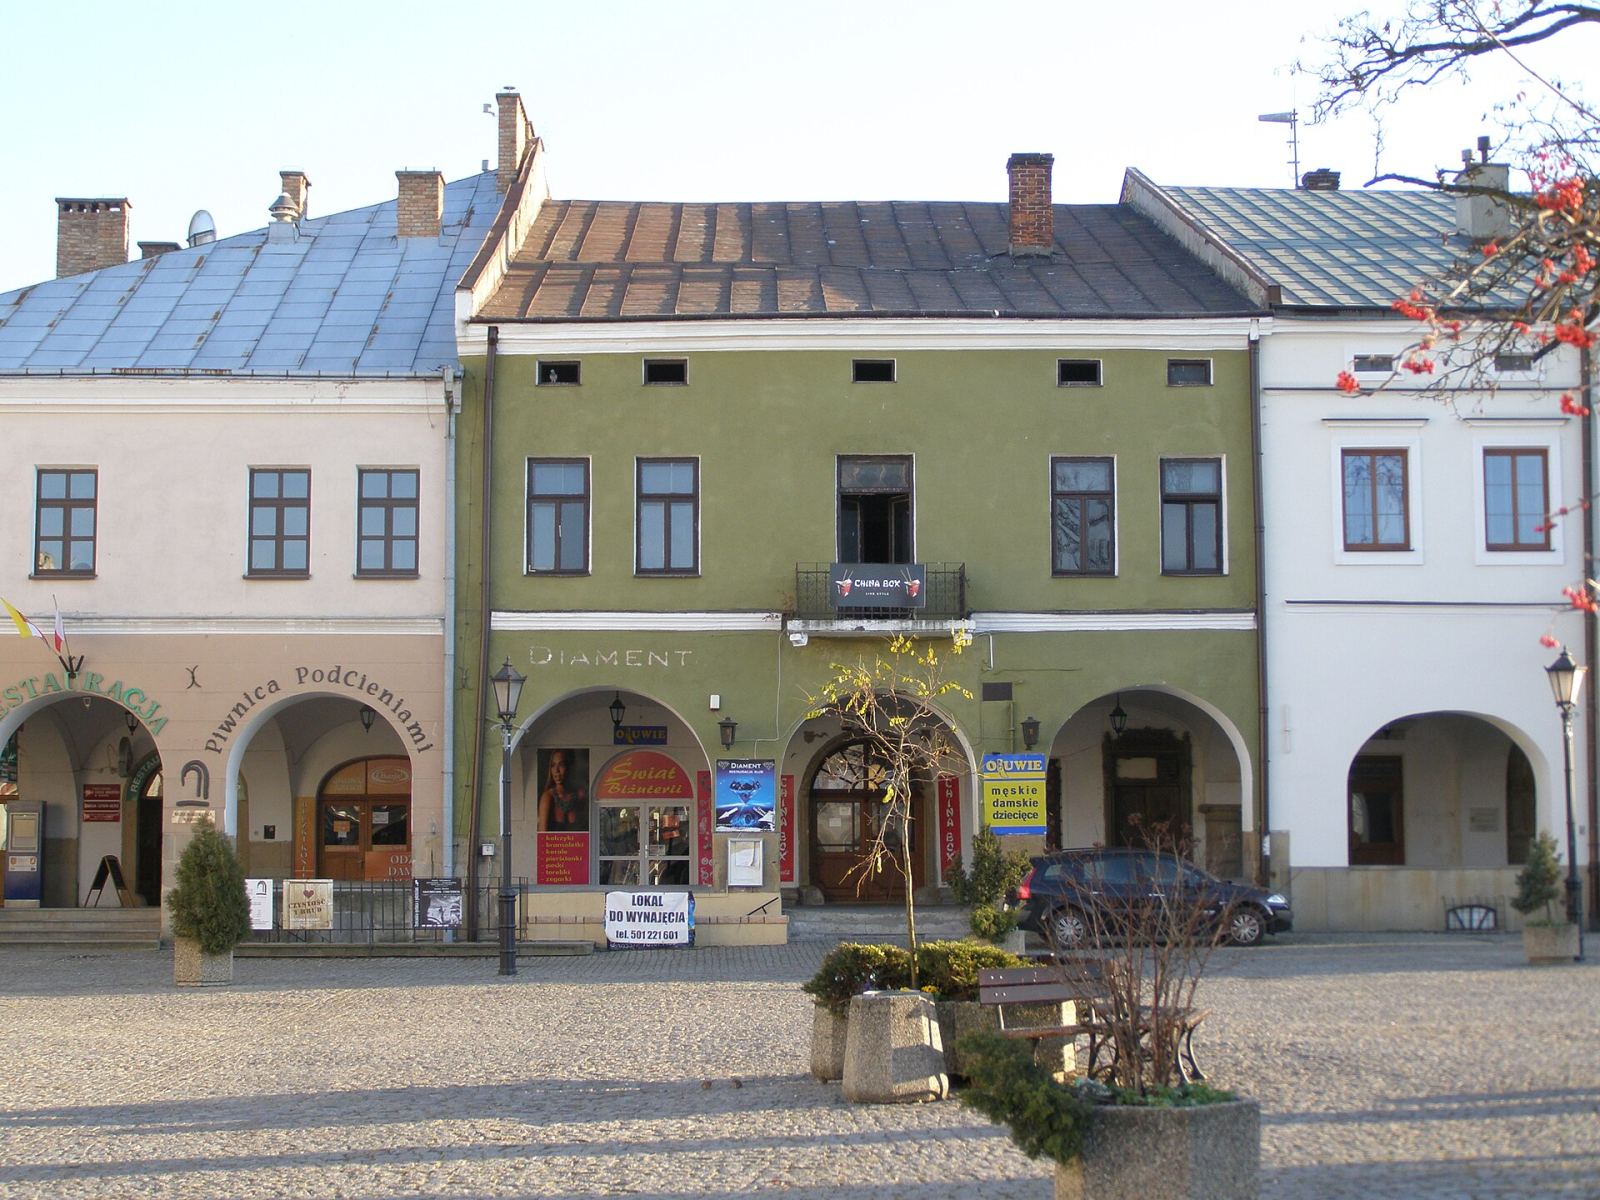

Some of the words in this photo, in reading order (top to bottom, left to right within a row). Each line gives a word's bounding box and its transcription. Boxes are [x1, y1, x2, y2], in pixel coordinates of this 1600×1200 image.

[854, 579, 880, 588] CHINA
[882, 579, 901, 588] BOX
[529, 645, 693, 667] DIAMENT
[204, 679, 281, 755] Piwnica
[604, 757, 677, 785] Świat
[991, 785, 1038, 798] męskie
[945, 778, 955, 828] CHINA
[992, 798, 1039, 808] damskie
[992, 810, 1039, 822] dziecięce
[946, 832, 956, 861] BOX
[631, 894, 664, 907] LOKAL
[609, 910, 624, 922] DO
[626, 910, 686, 925] WYNAJĘCIA
[615, 930, 629, 939] tel.
